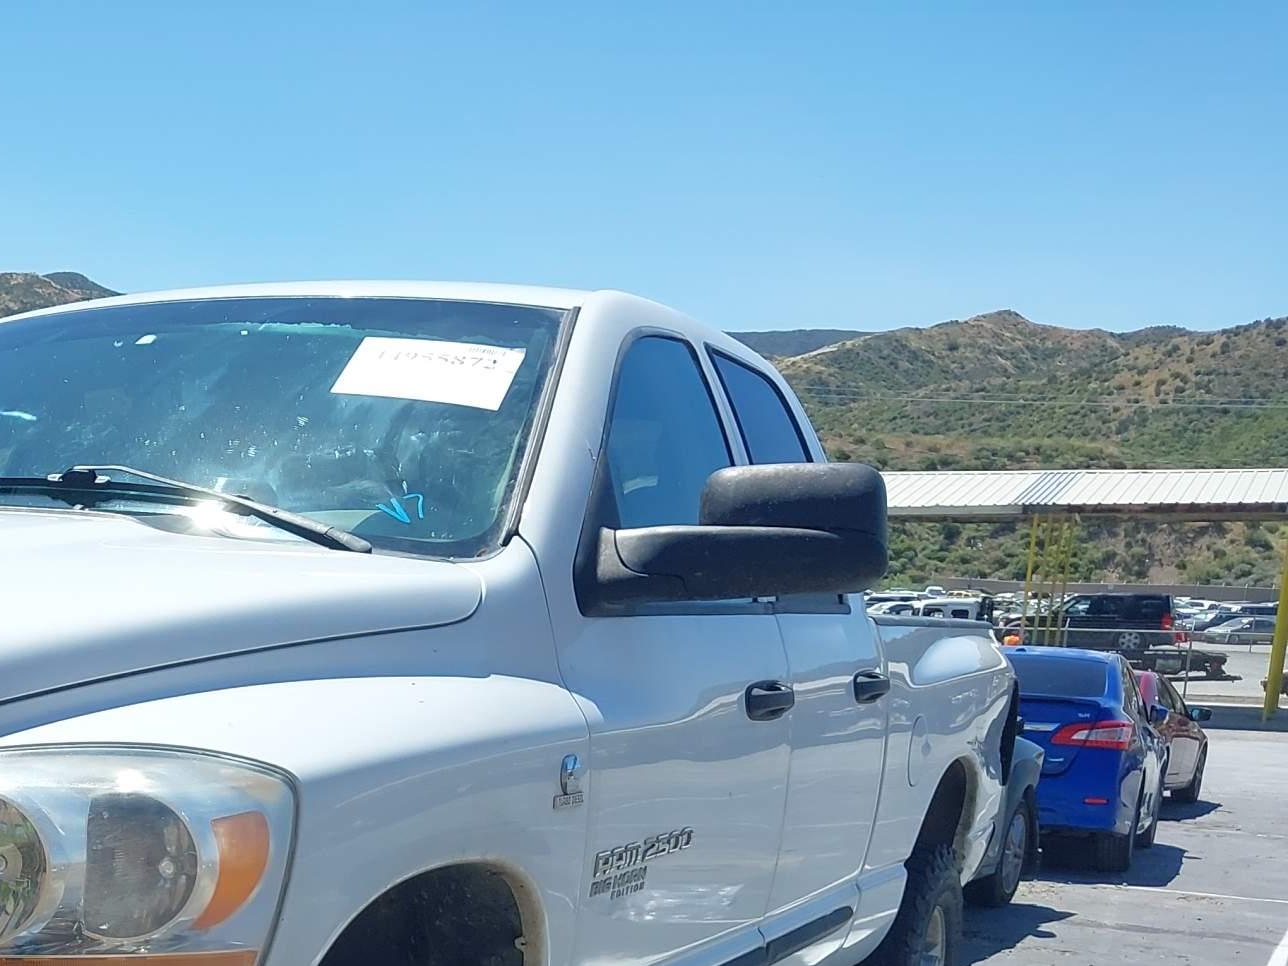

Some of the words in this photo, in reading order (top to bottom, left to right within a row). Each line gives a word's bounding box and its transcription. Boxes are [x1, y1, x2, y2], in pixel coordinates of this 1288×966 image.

[594, 841, 642, 878] RAM
[642, 826, 694, 862] 2500
[589, 875, 612, 898] BIG
[611, 866, 648, 890] HORN
[610, 881, 645, 900] EDITION
